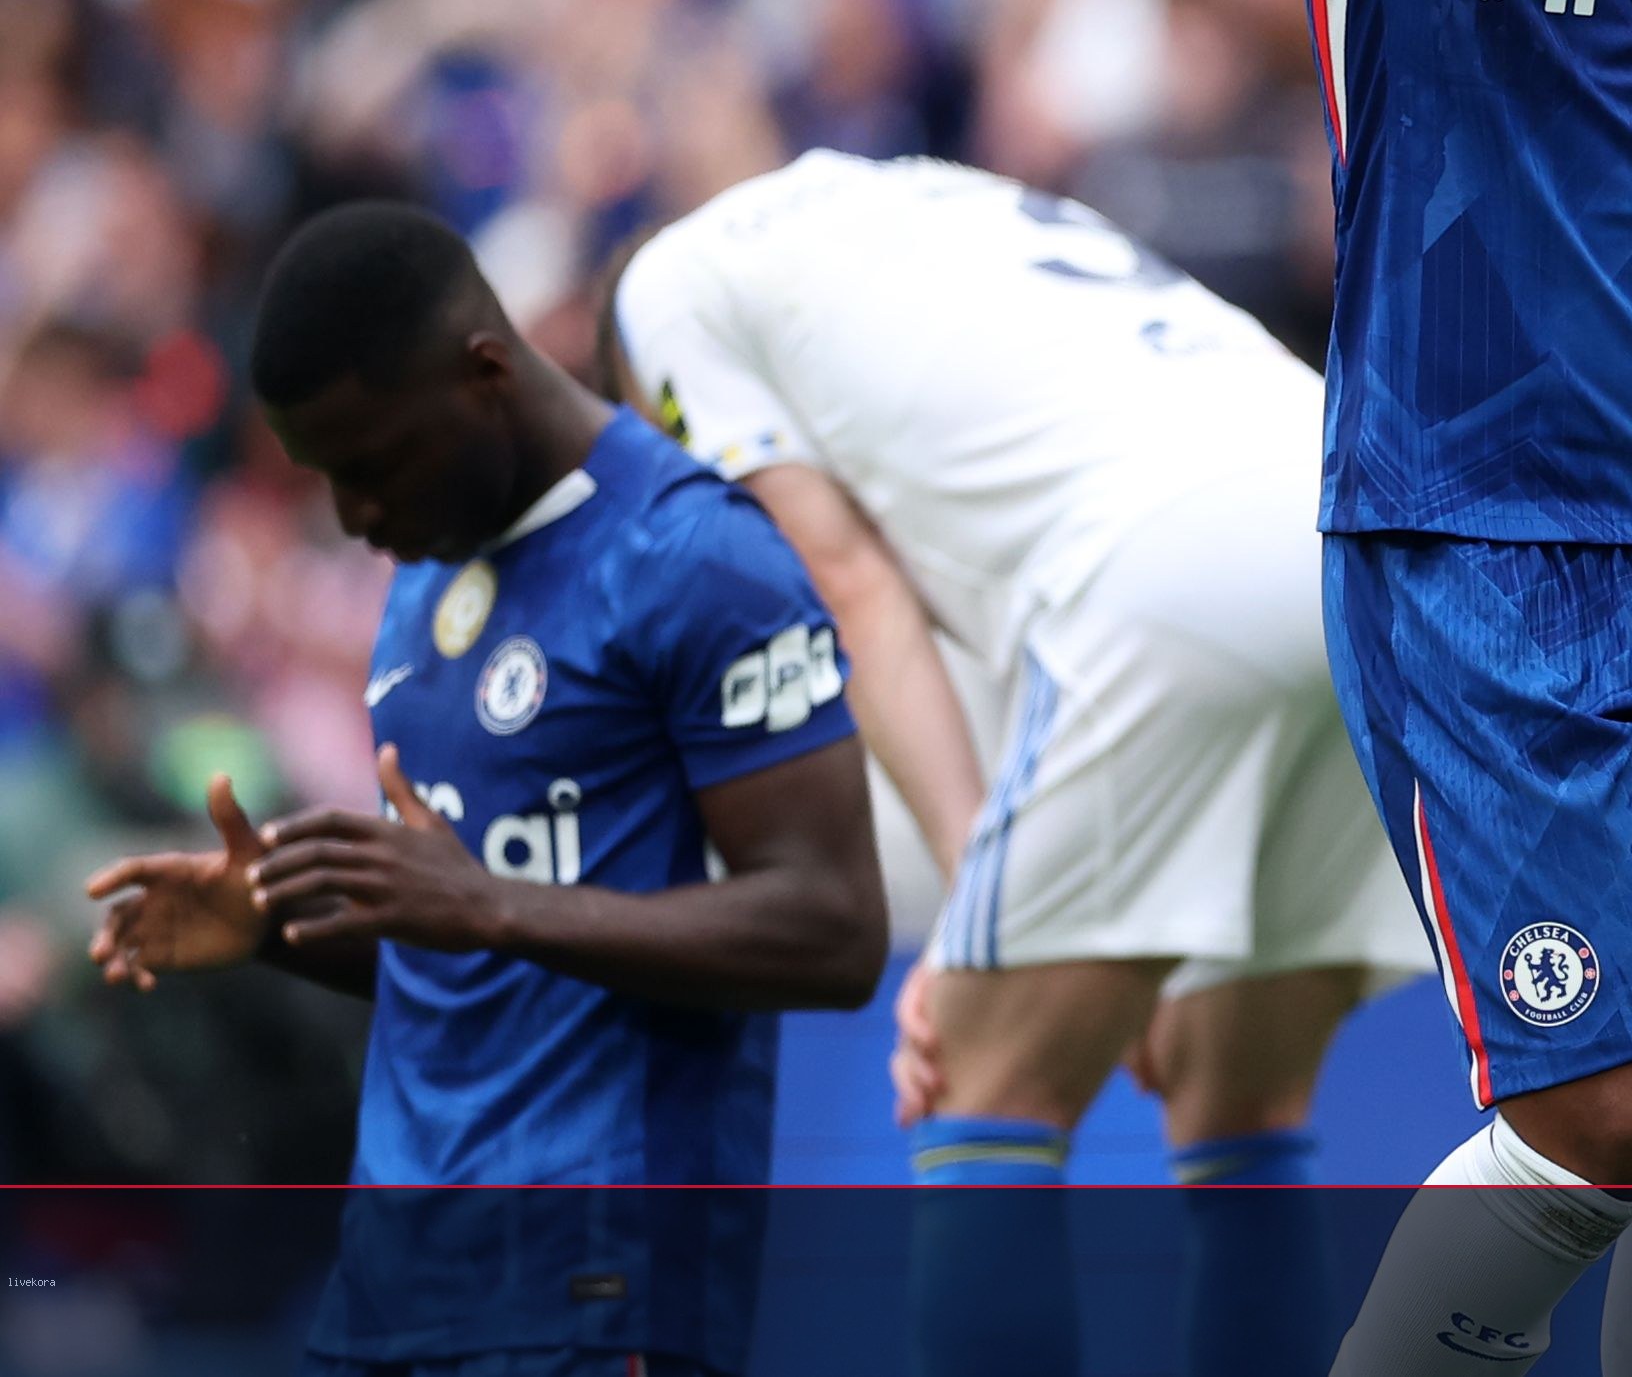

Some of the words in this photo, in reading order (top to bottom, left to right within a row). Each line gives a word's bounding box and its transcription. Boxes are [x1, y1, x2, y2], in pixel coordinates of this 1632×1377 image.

[1509, 927, 1569, 957] CHELSEA
[1524, 1009, 1567, 1020] FOOTBALL
[1569, 992, 1588, 1012] CLUB
[1451, 1311, 1530, 1349] CFC
